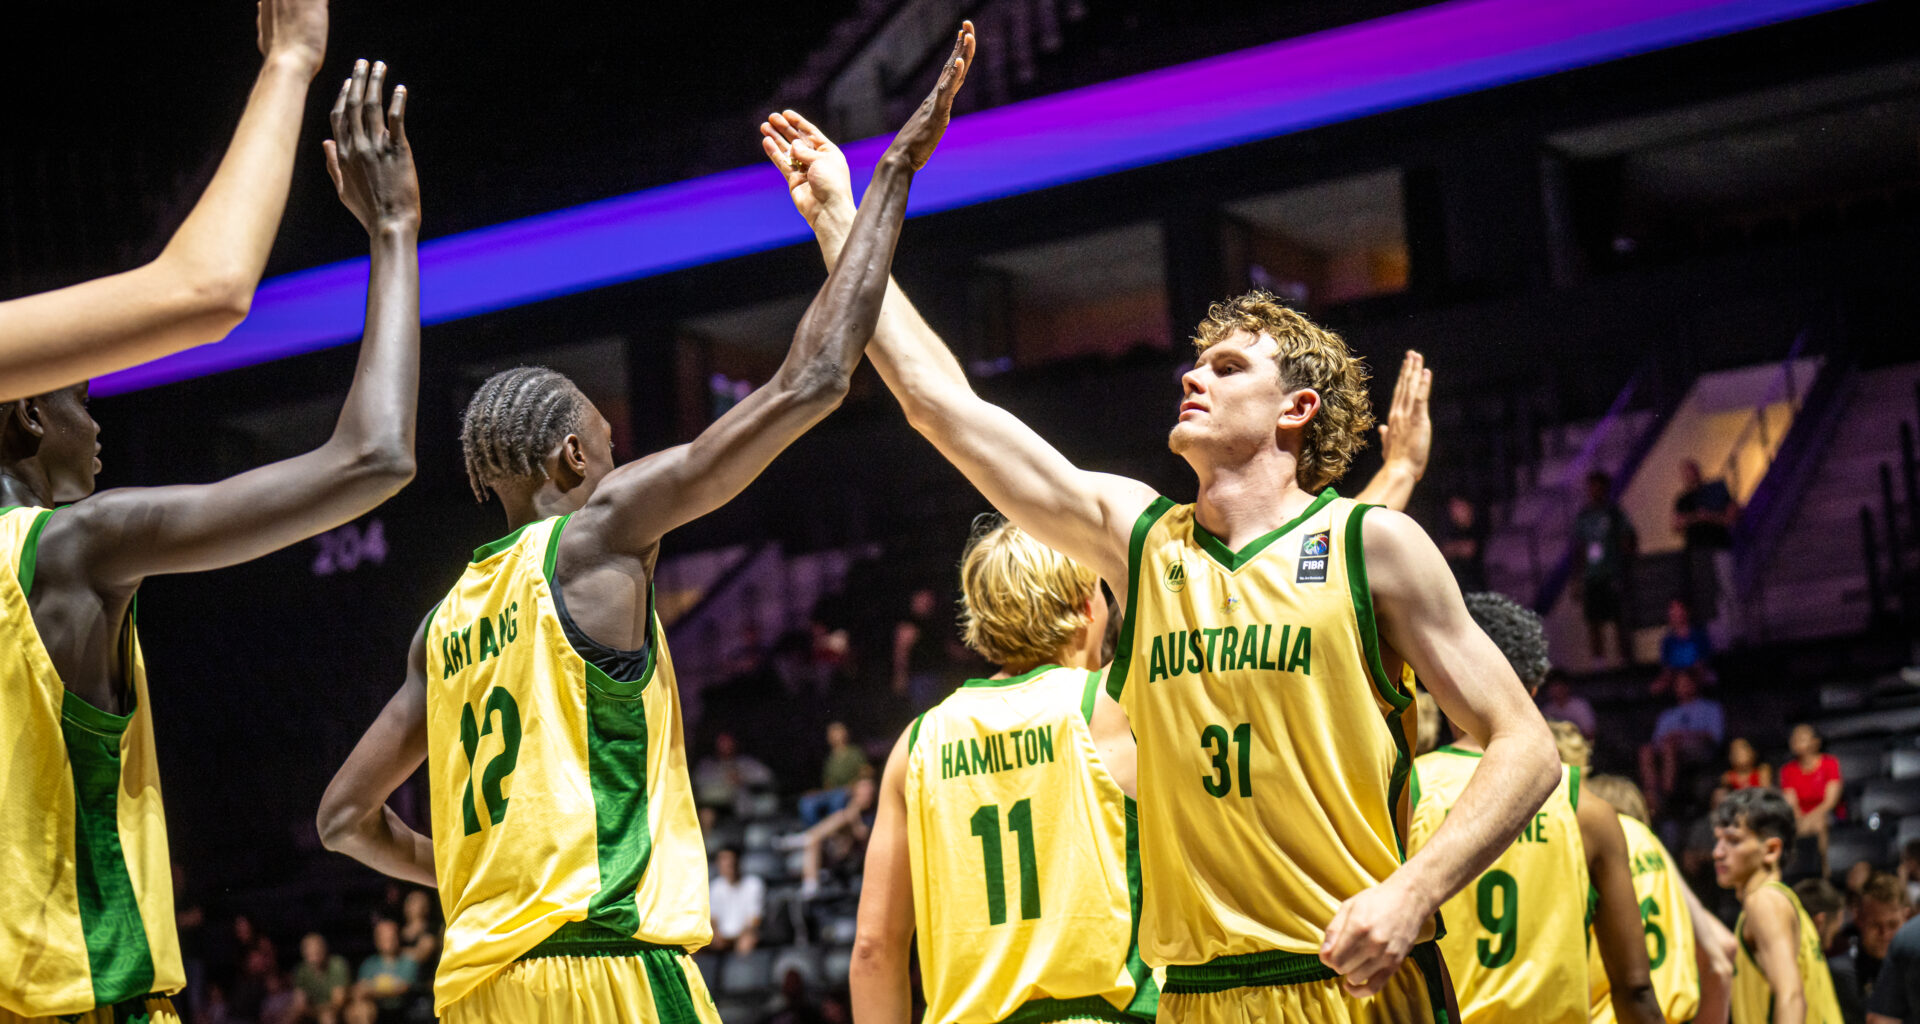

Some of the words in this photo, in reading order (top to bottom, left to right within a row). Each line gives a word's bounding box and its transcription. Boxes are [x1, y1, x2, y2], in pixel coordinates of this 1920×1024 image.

[1302, 560, 1325, 570] FIBA
[1149, 624, 1312, 683] AUSTRALIA
[460, 686, 522, 837] 12
[941, 725, 1054, 780] HAMILTON
[1201, 723, 1252, 799] 31
[970, 798, 1041, 926] 11
[1476, 869, 1518, 969] 9
